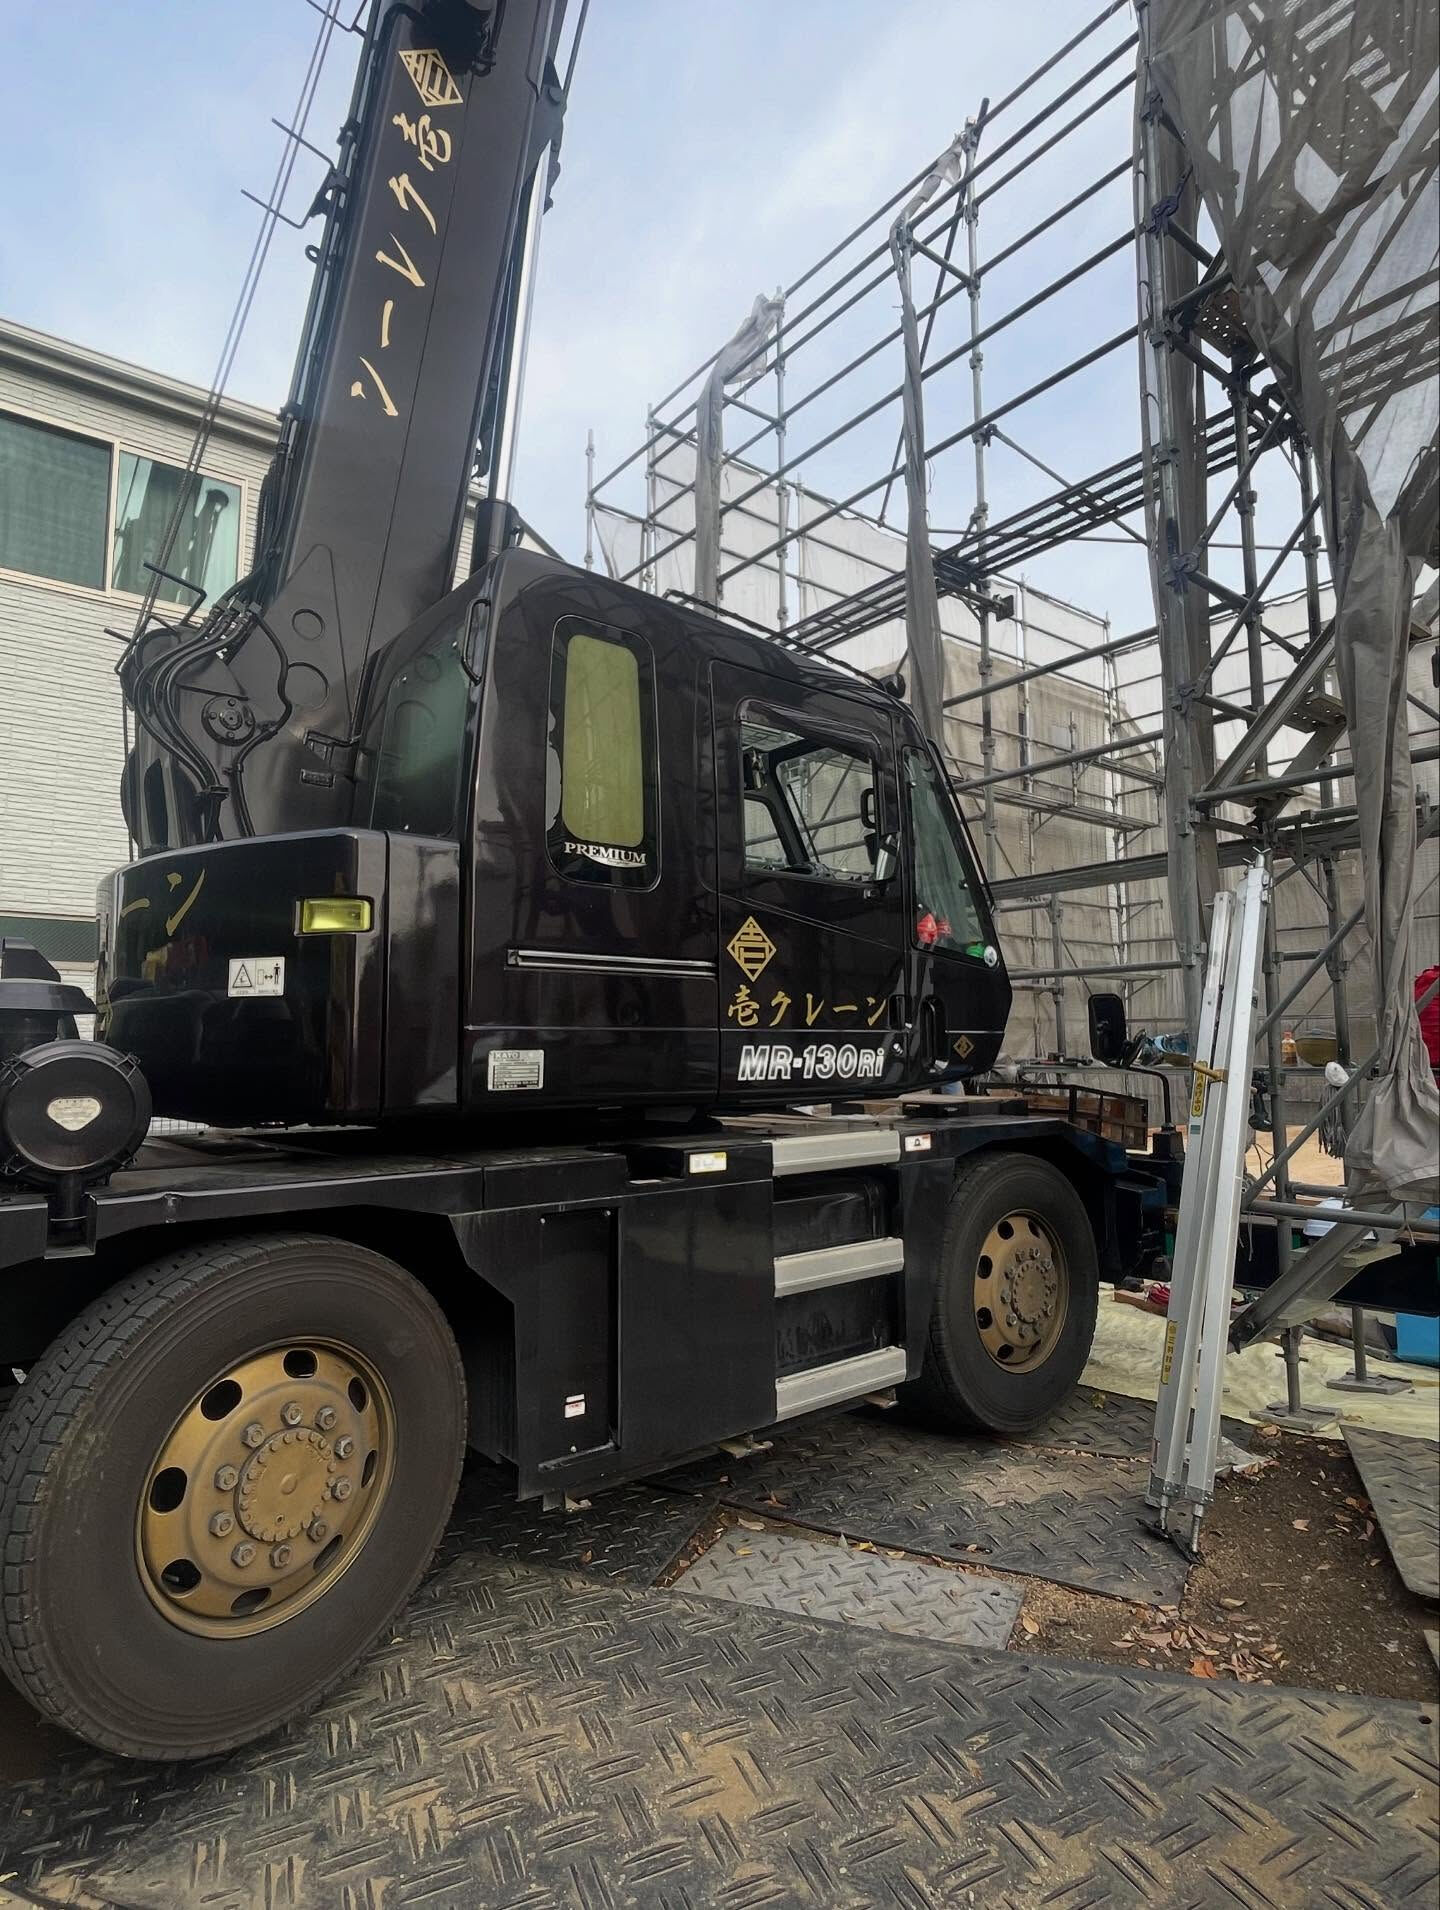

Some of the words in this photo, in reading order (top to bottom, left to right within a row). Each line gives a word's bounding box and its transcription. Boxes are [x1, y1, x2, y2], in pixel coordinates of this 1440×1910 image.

[564, 841, 646, 865] PREMIUM
[727, 984, 887, 1027] 壱クレーン
[737, 1043, 885, 1081] MR-130Ri
